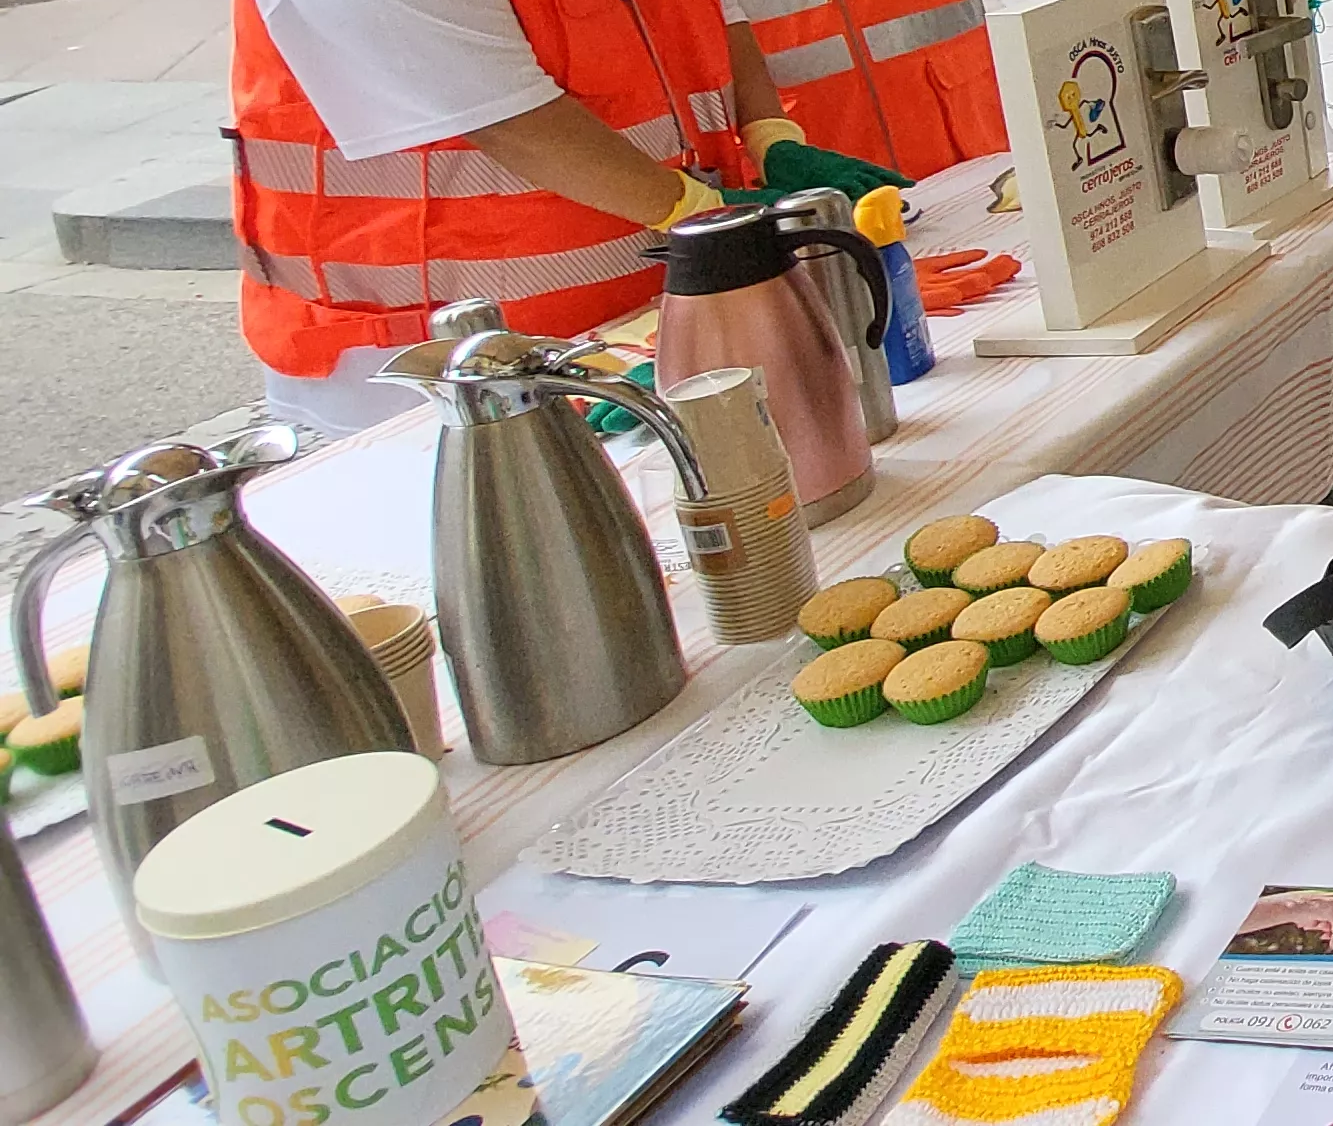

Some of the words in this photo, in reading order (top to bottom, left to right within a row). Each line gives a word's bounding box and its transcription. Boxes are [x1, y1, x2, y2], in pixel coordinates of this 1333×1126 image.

[1081, 158, 1135, 194] cerrajeros
[202, 859, 468, 1024] ASOCIACIÓ
[1248, 1015, 1276, 1029] 091
[1302, 1017, 1332, 1030] 062
[1299, 1083, 1327, 1093] forma
